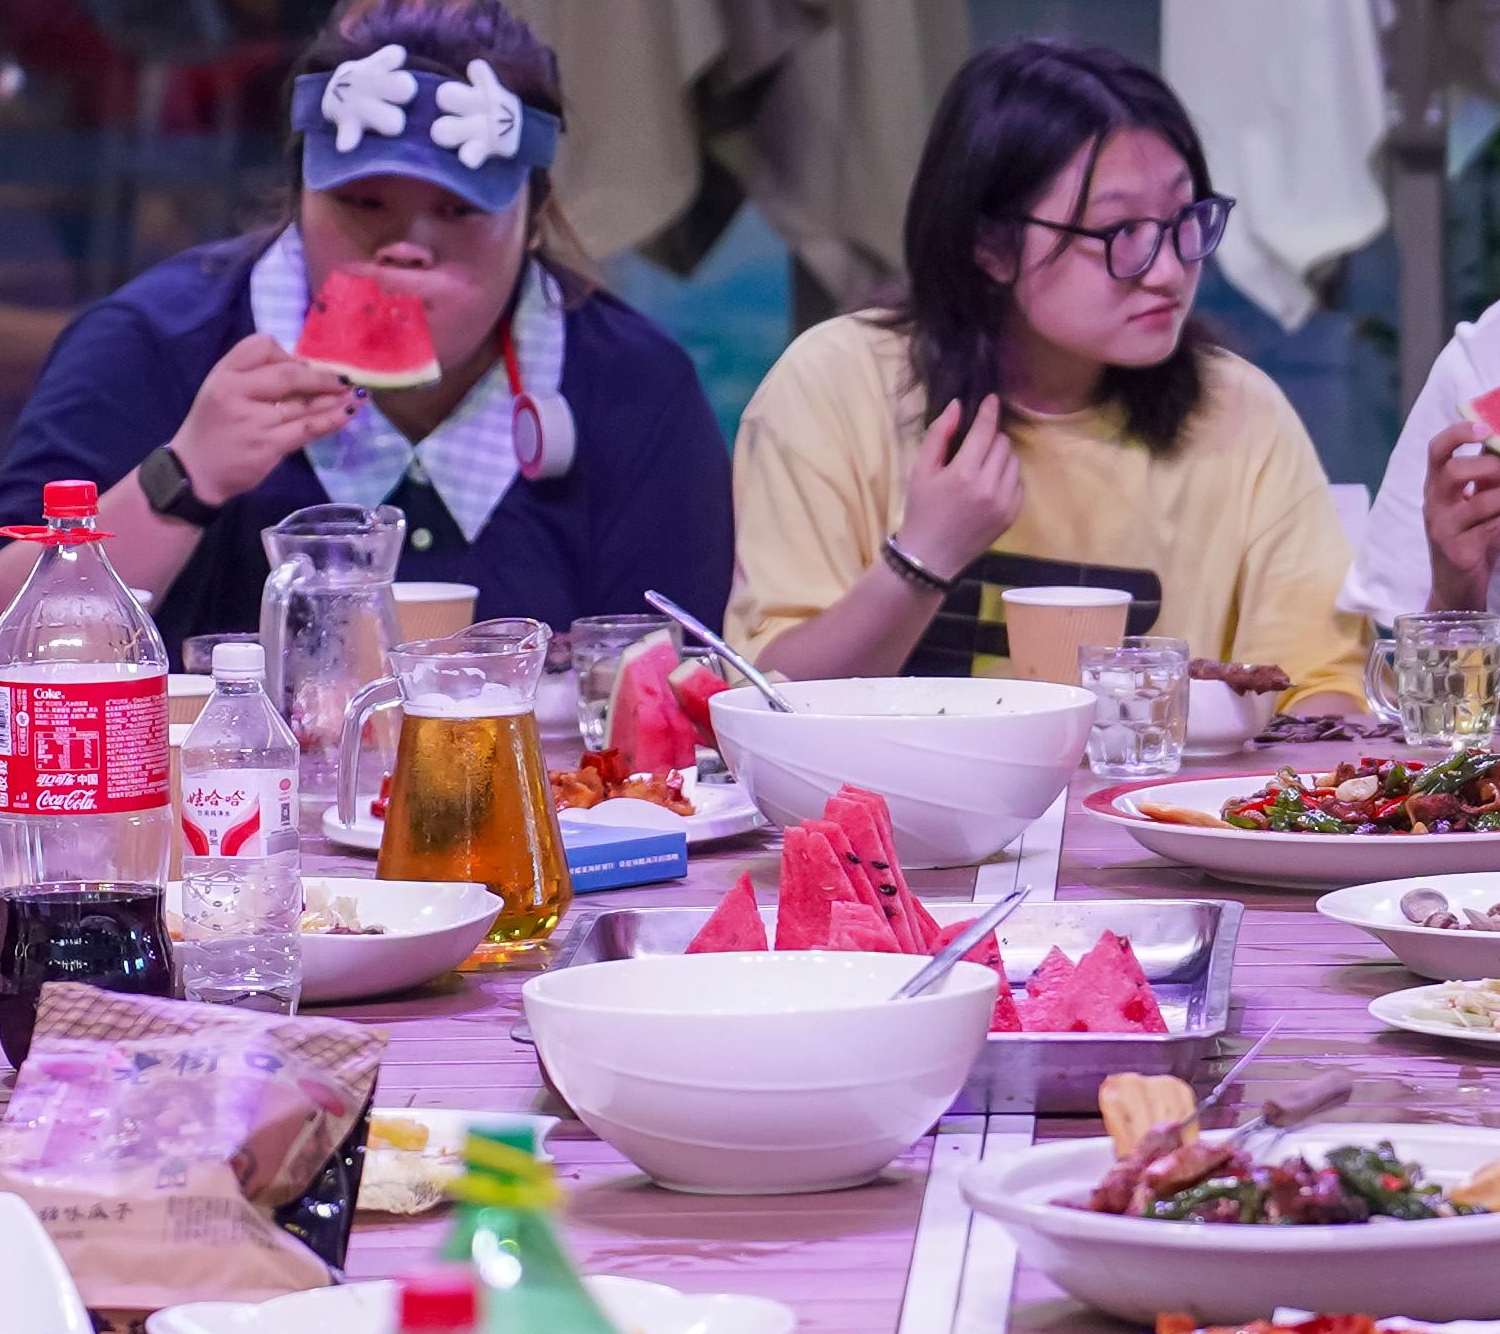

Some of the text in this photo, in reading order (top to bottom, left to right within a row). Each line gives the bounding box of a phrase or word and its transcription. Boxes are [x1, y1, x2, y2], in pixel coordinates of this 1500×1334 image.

[33, 688, 63, 700] Coke
[36, 773, 99, 787] 可口可乐 中国
[186, 787, 245, 807] 娃哈哈
